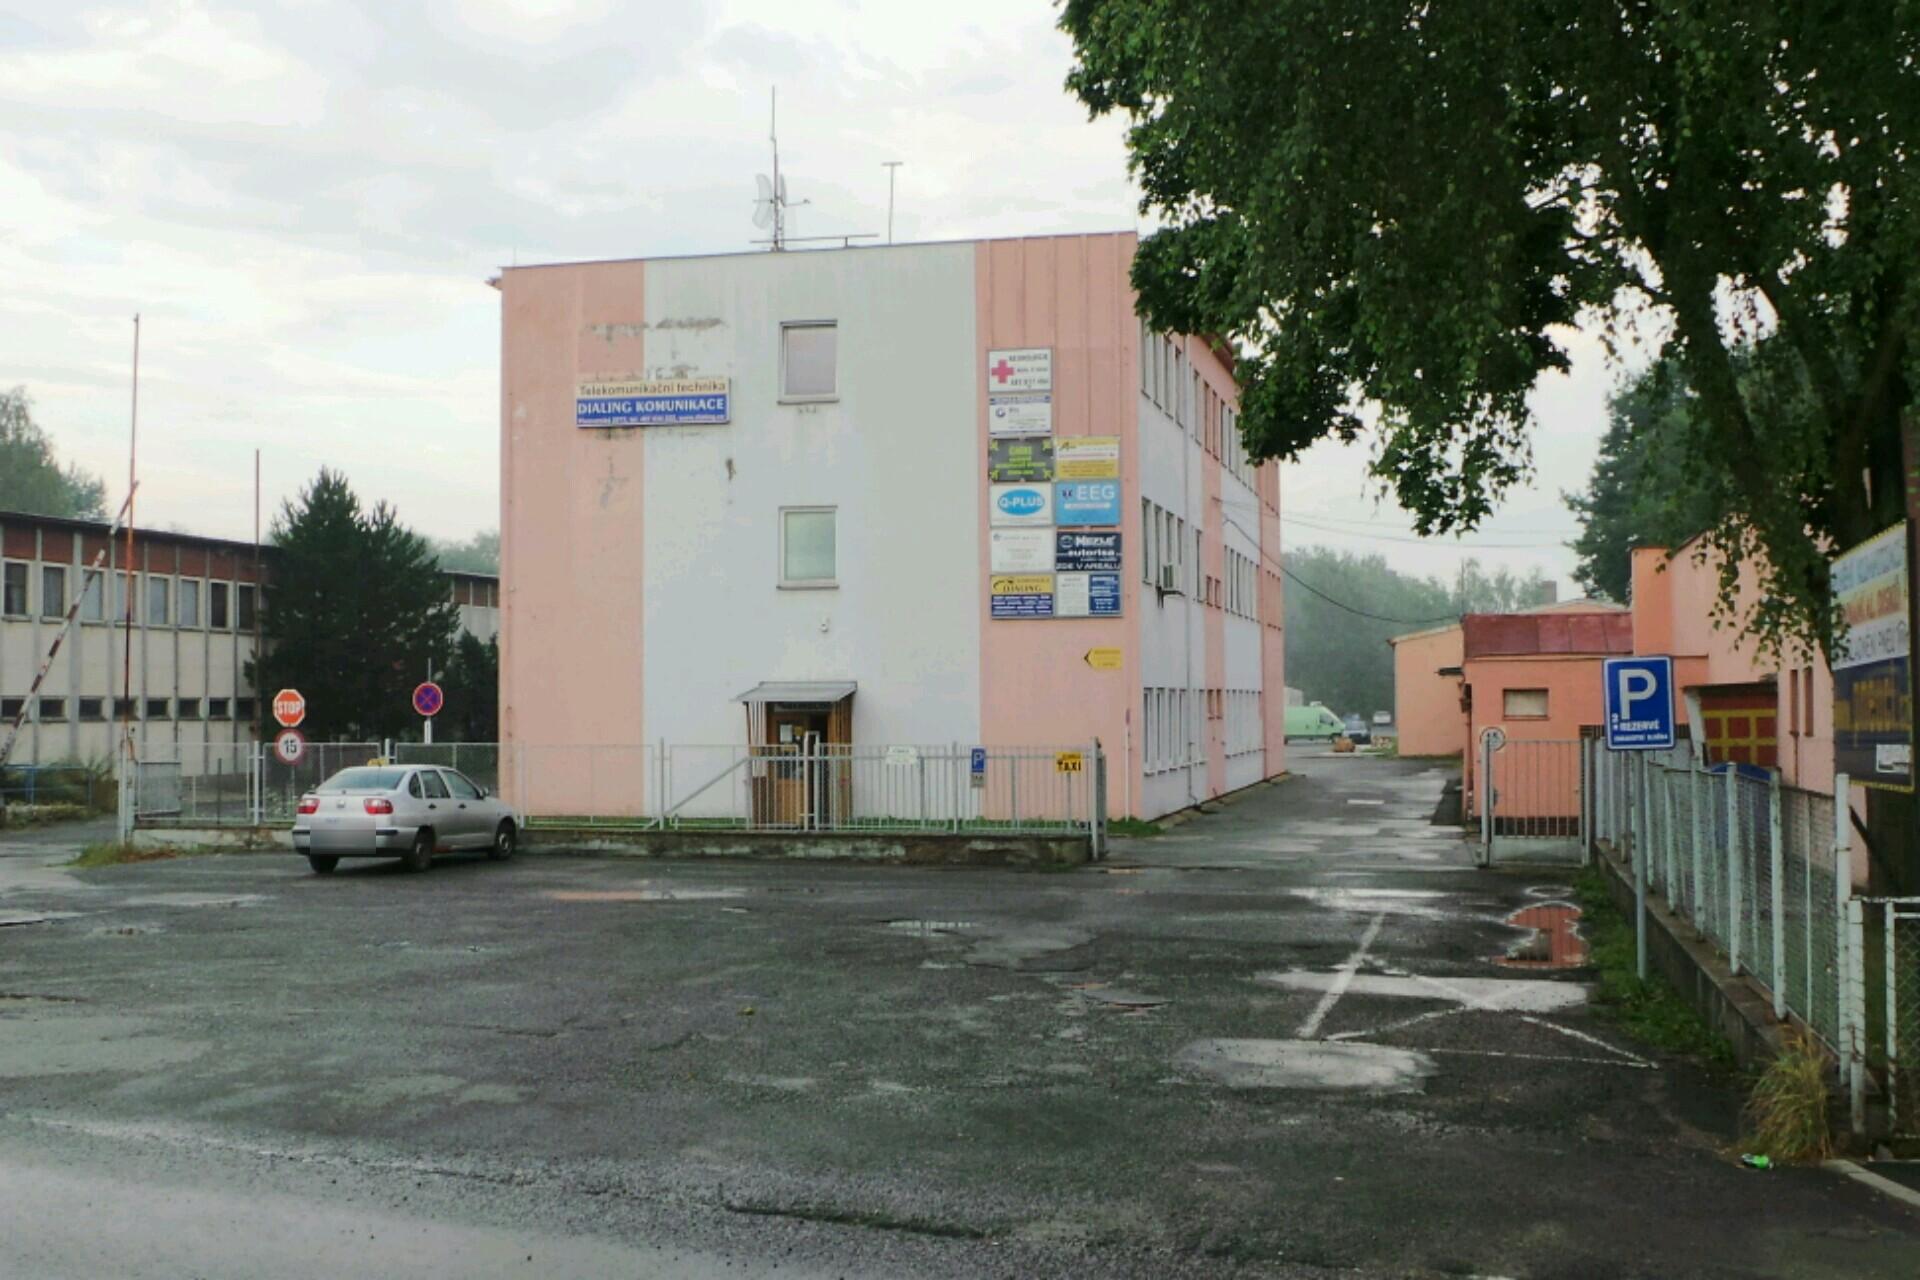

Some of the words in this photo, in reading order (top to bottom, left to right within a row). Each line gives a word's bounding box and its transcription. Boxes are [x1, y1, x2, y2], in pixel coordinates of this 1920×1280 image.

[580, 383, 674, 396] Telekomunikační
[677, 381, 726, 393] technika
[578, 402, 632, 415] DIALING
[636, 398, 725, 413] KOMUNIKACE
[1077, 484, 1115, 501] EEG
[1618, 668, 1658, 720] P
[277, 700, 302, 715] STOP
[284, 737, 297, 754] 15
[973, 752, 983, 769] P
[1057, 759, 1082, 772] TAXI
